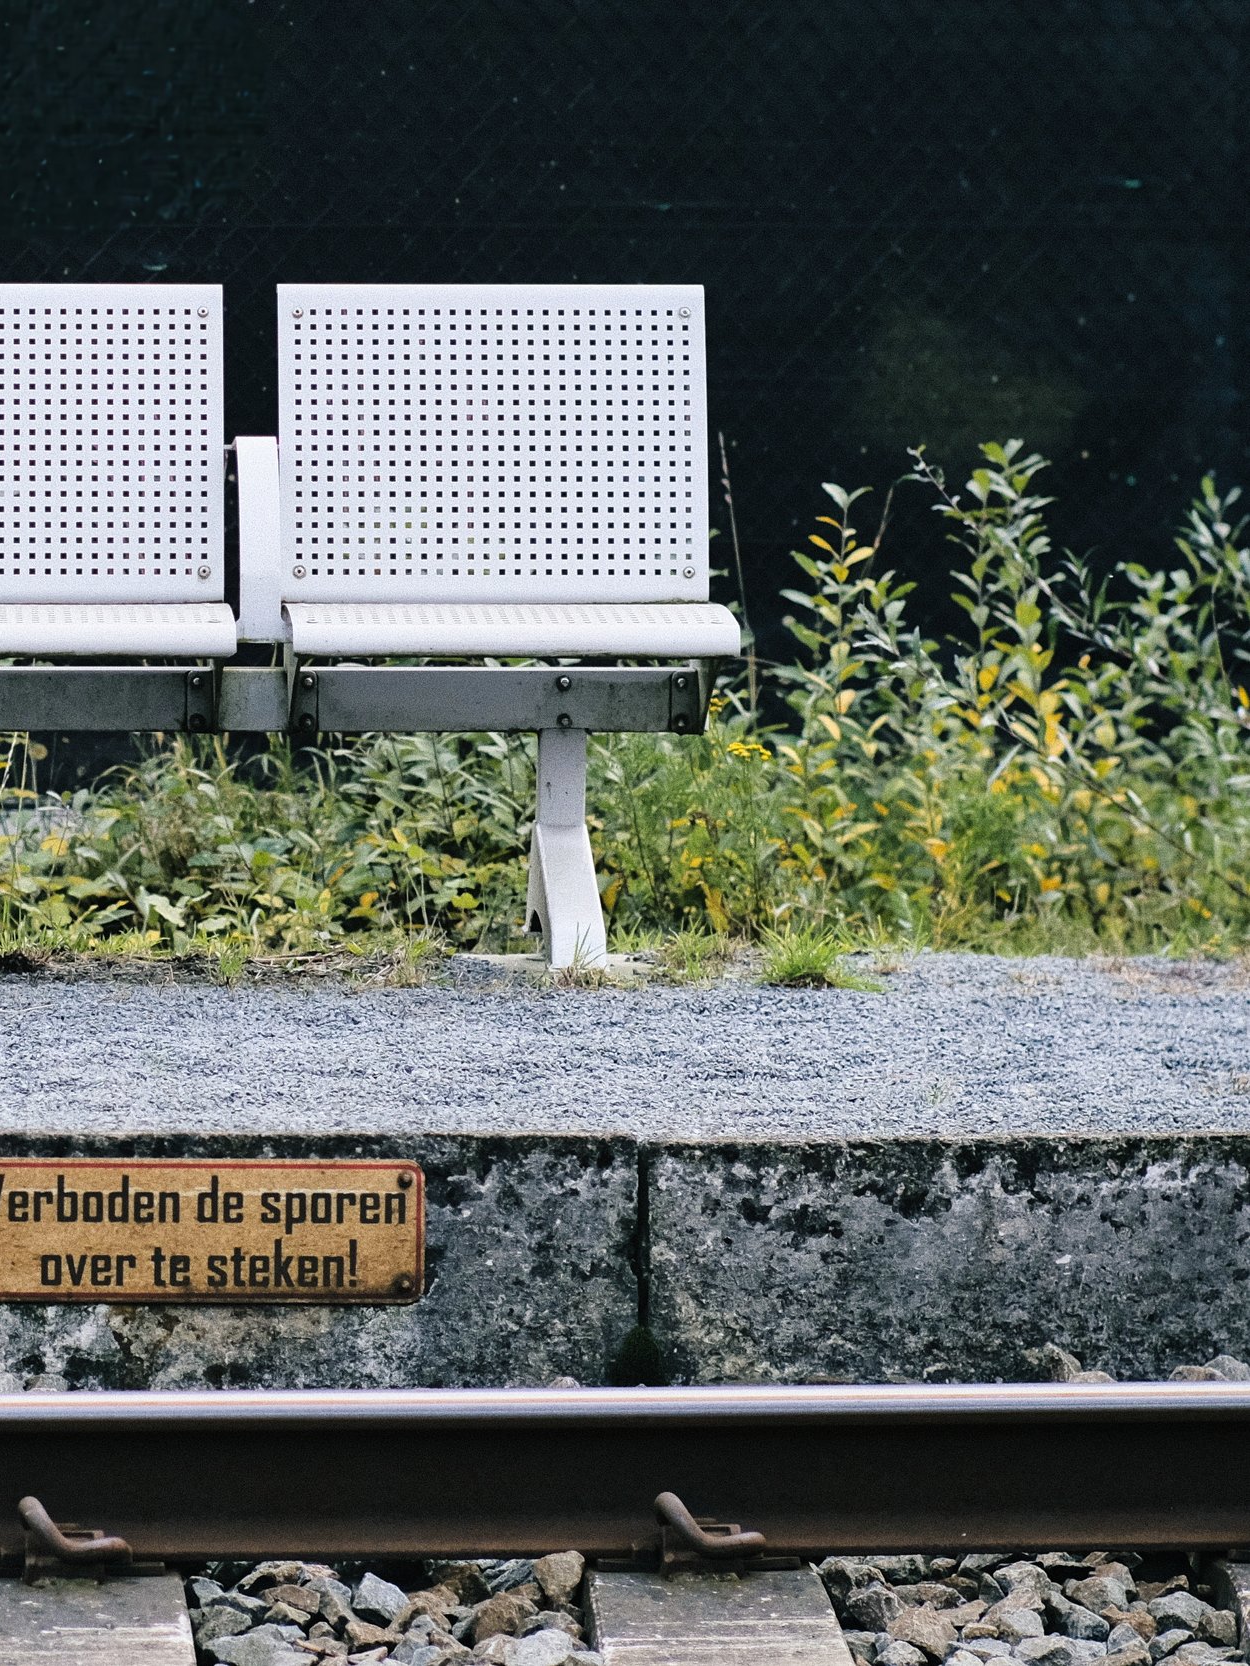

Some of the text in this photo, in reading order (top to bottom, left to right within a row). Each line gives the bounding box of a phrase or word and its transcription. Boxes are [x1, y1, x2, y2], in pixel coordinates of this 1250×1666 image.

[196, 1174, 245, 1224] de
[260, 1188, 407, 1234] sporen
[40, 1238, 359, 1288] over te steken!
